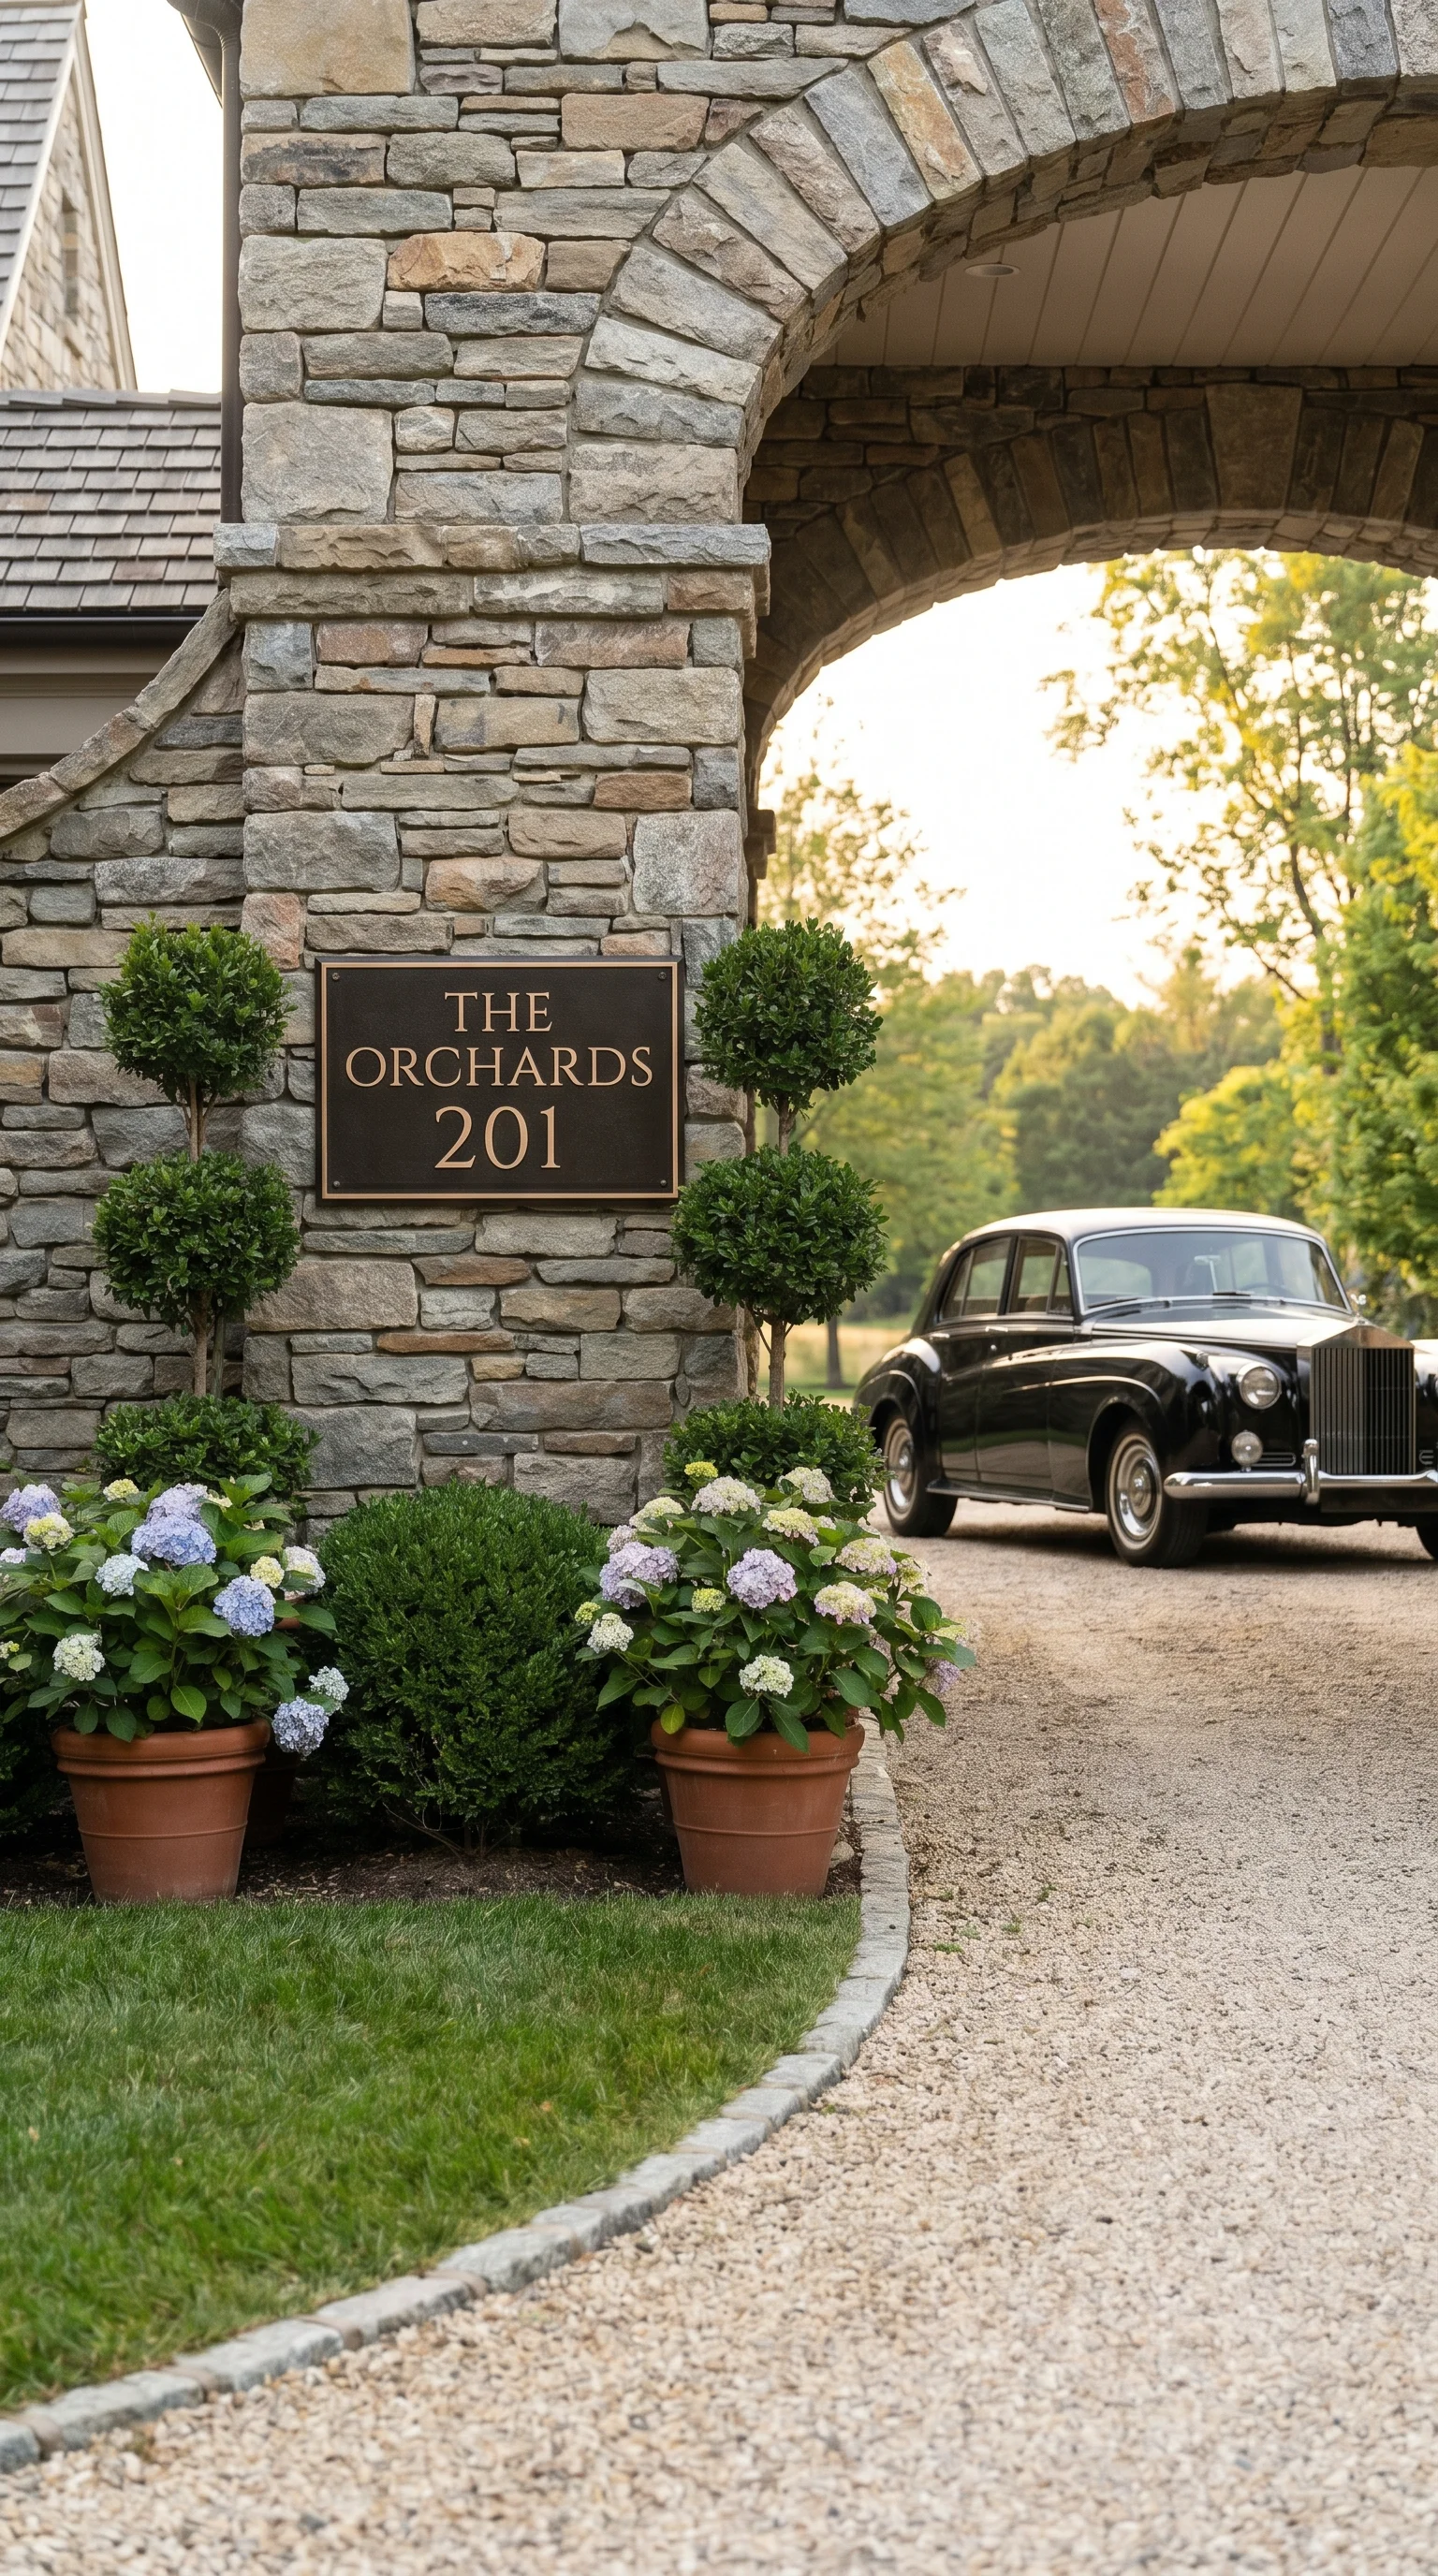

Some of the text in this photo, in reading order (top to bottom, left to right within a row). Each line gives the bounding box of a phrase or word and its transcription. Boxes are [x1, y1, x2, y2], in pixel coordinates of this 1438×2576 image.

[444, 991, 553, 1032] THE
[345, 1046, 653, 1088] ORCHARDS
[434, 1105, 561, 1170] 201
